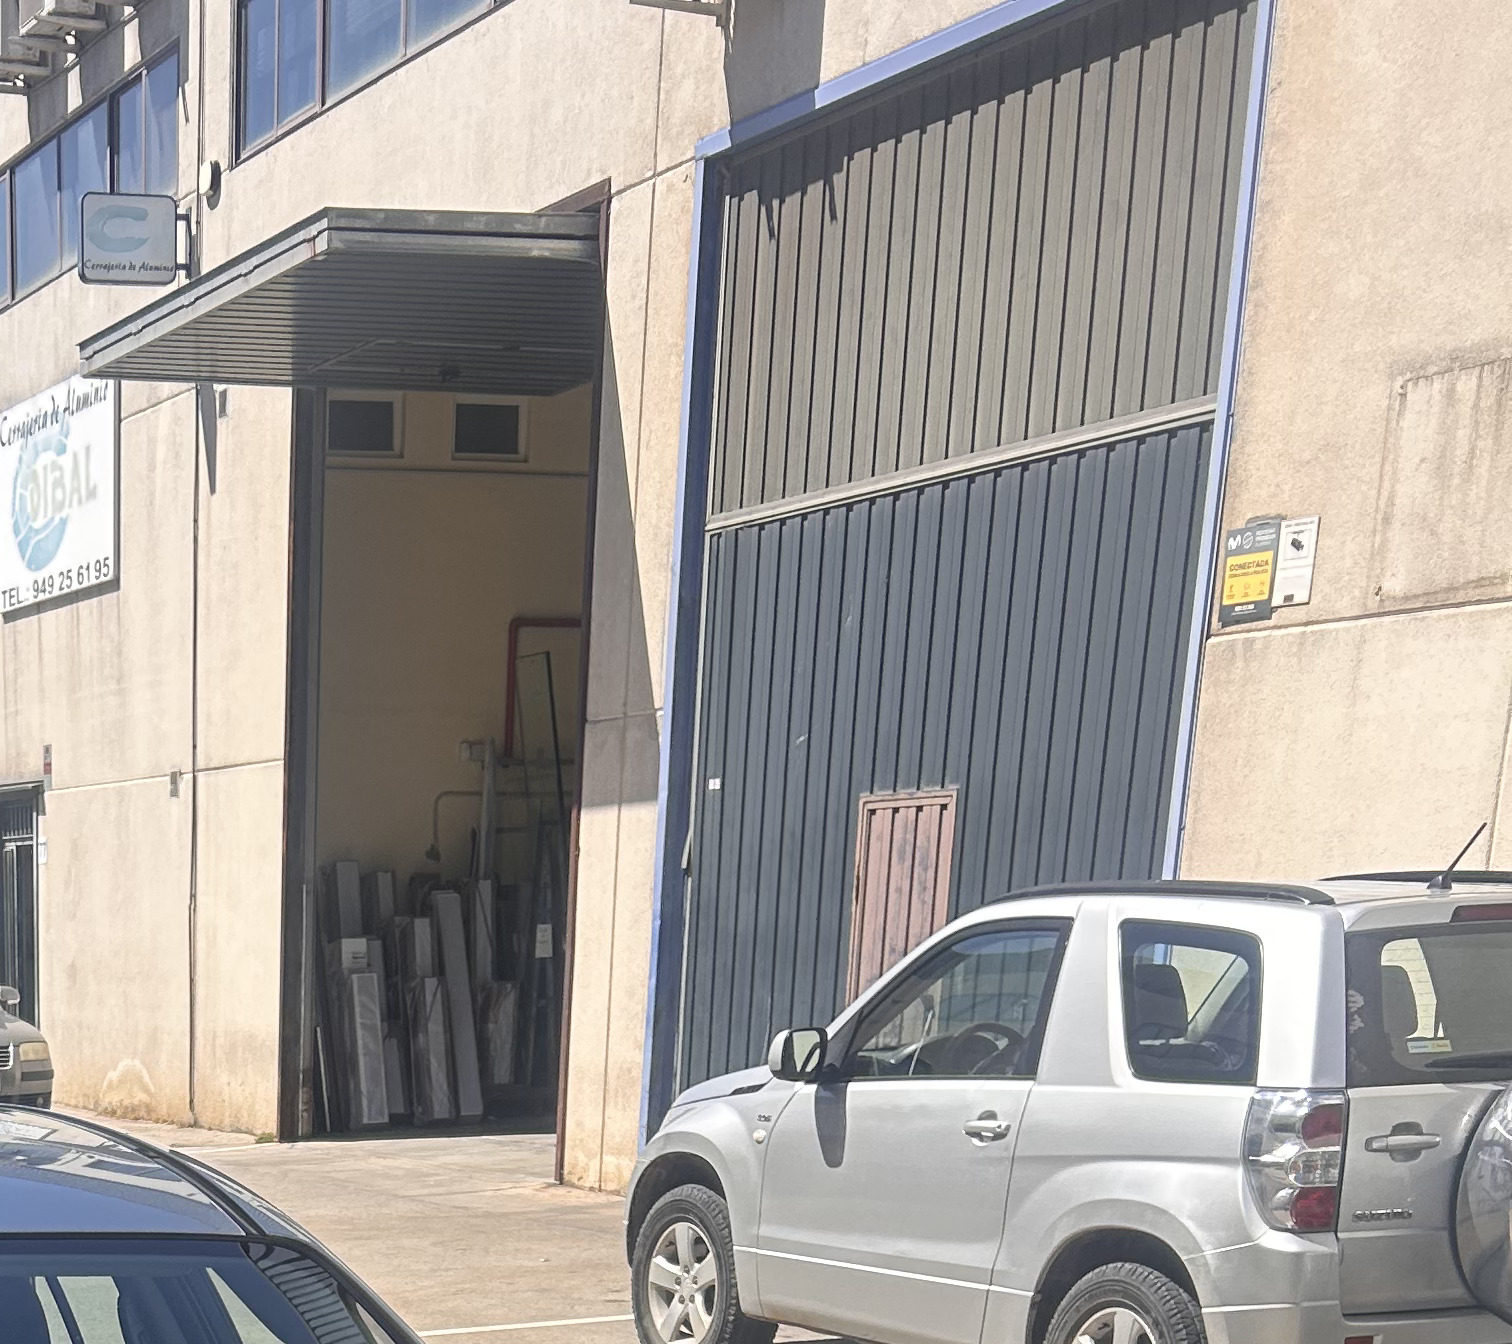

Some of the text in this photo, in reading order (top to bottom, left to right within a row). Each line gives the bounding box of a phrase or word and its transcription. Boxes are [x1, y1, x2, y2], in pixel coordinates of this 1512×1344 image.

[50, 395, 60, 426] de
[61, 380, 108, 432] Aluminio
[28, 444, 98, 521] DIBAL
[32, 575, 54, 599] 949
[58, 568, 73, 592] 25
[77, 562, 90, 586] 61
[94, 556, 110, 581] 95
